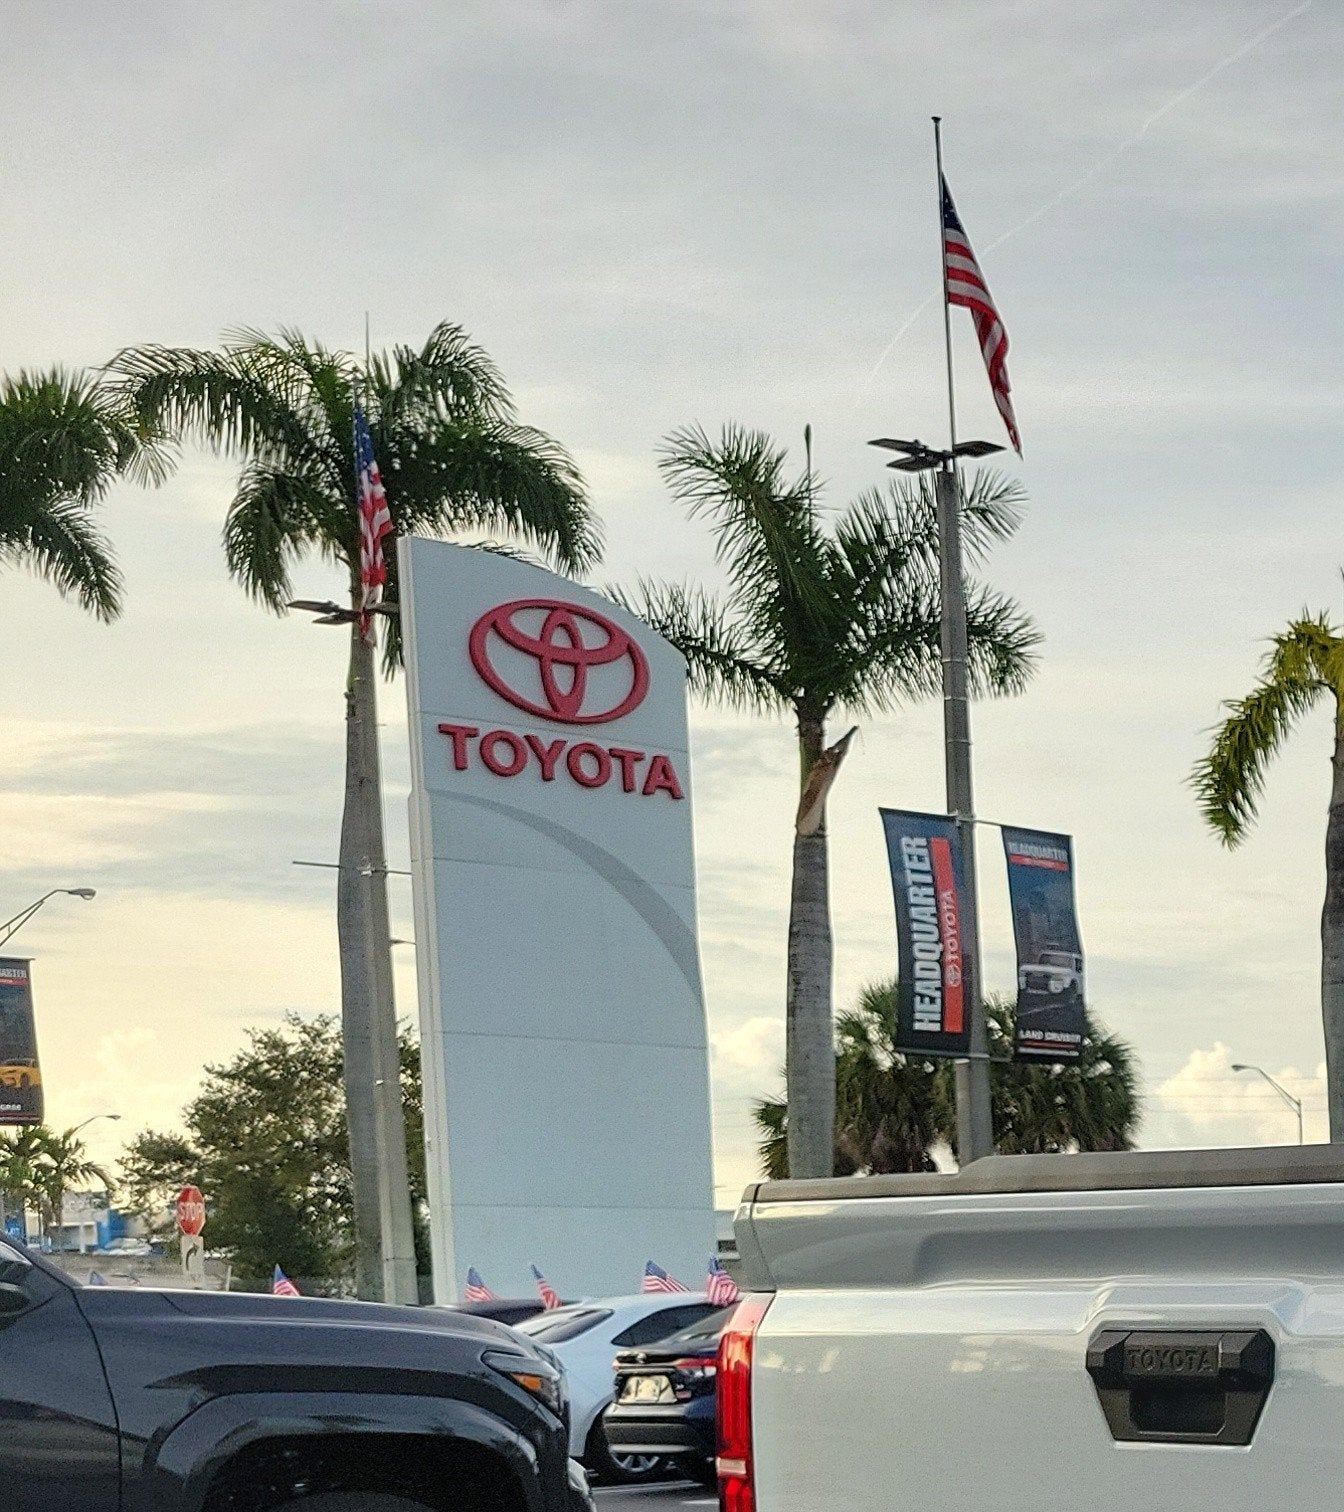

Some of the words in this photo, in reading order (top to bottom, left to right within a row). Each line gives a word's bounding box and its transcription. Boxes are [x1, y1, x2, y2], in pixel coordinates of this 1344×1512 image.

[438, 723, 685, 799] TOYOTA
[902, 836, 943, 1032] HEADQUARTER
[941, 890, 962, 960] TOYOTA
[179, 1201, 203, 1221] STOP
[1127, 1348, 1214, 1372] TOYOTA
